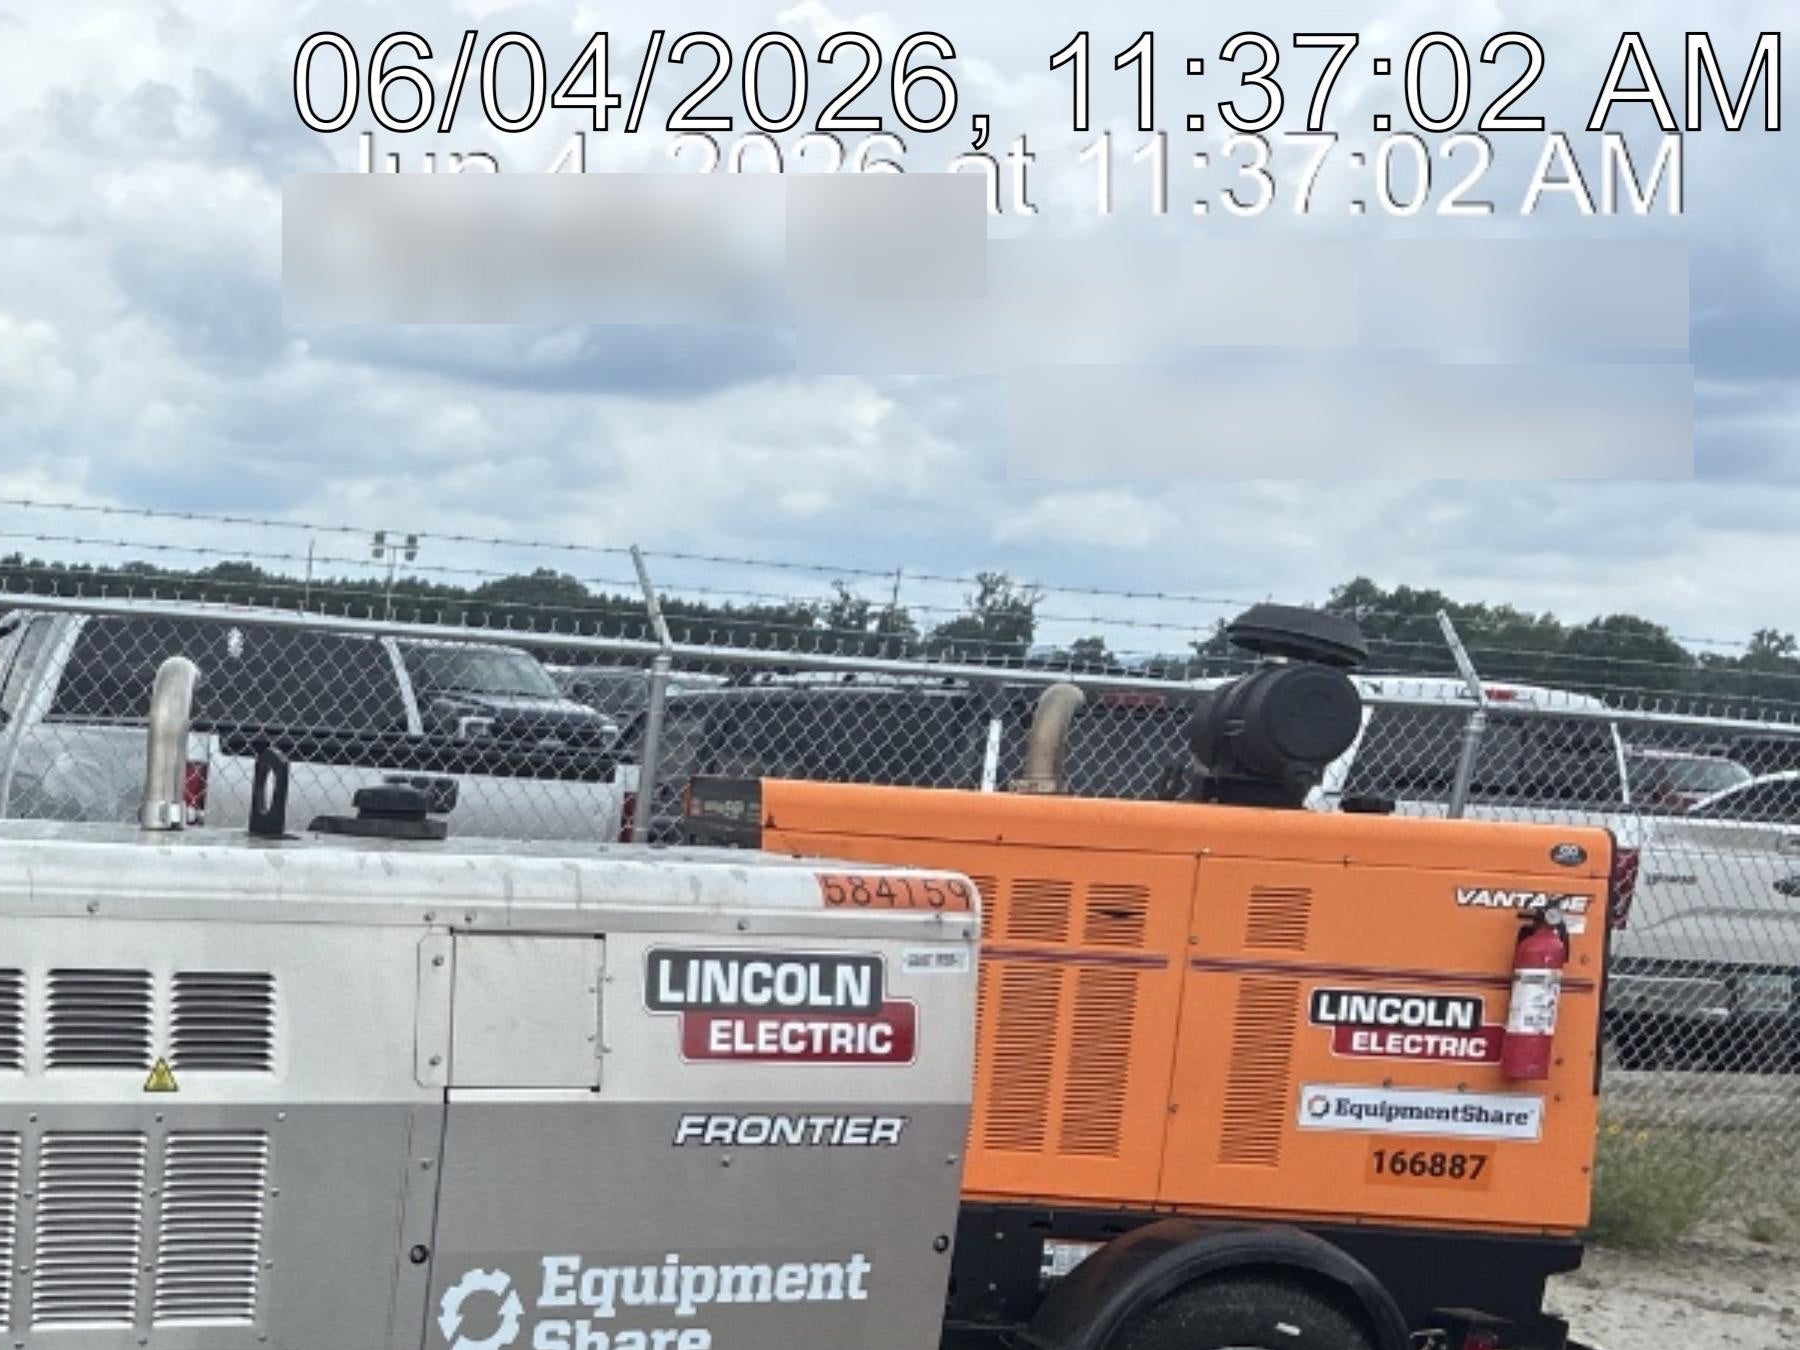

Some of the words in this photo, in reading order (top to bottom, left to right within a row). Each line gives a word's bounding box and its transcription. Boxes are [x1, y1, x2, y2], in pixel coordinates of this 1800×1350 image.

[821, 873, 971, 910] 584159
[1456, 886, 1592, 913] VANTAE
[658, 959, 871, 1007] LINCOLN
[1318, 994, 1475, 1029] LINCOLN
[708, 1018, 894, 1055] ELECTRIC
[1351, 1030, 1489, 1058] ELECTRIC
[1334, 1096, 1531, 1127] EquipmentShare
[673, 1113, 907, 1146] FRONTIER
[1373, 1150, 1489, 1181] 166887
[536, 1253, 872, 1318] Equipment
